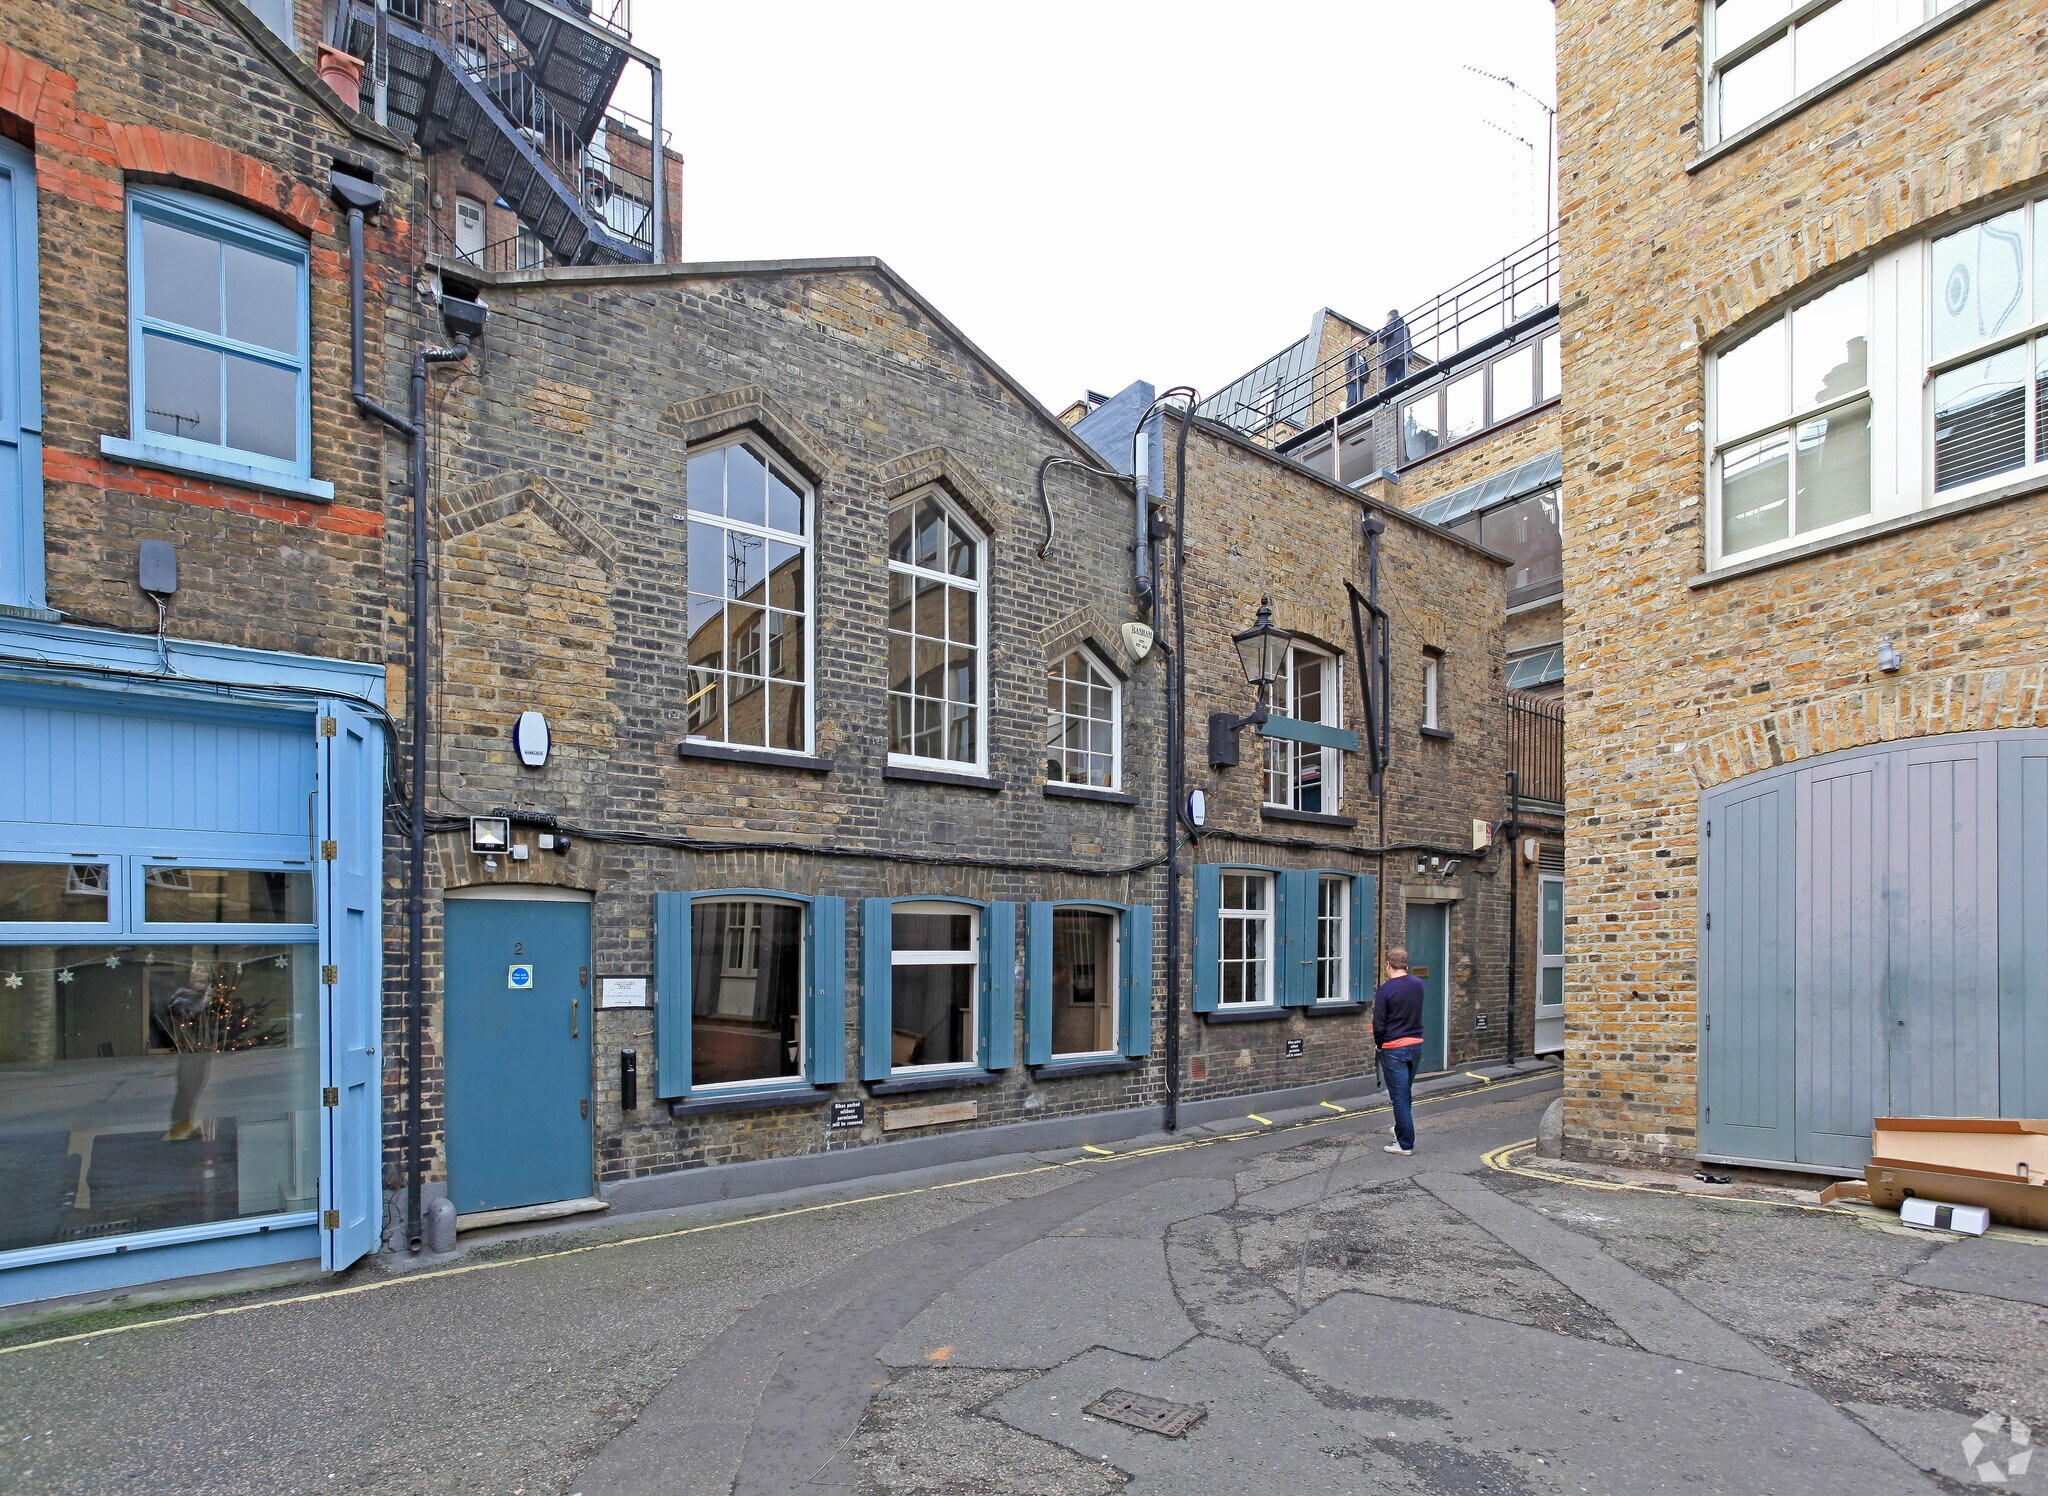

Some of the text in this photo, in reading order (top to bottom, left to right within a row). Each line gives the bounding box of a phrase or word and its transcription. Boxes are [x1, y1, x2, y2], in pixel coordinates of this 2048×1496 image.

[1131, 625, 1152, 639] BANHAM
[514, 942, 523, 955] 2
[847, 1101, 861, 1109] parked
